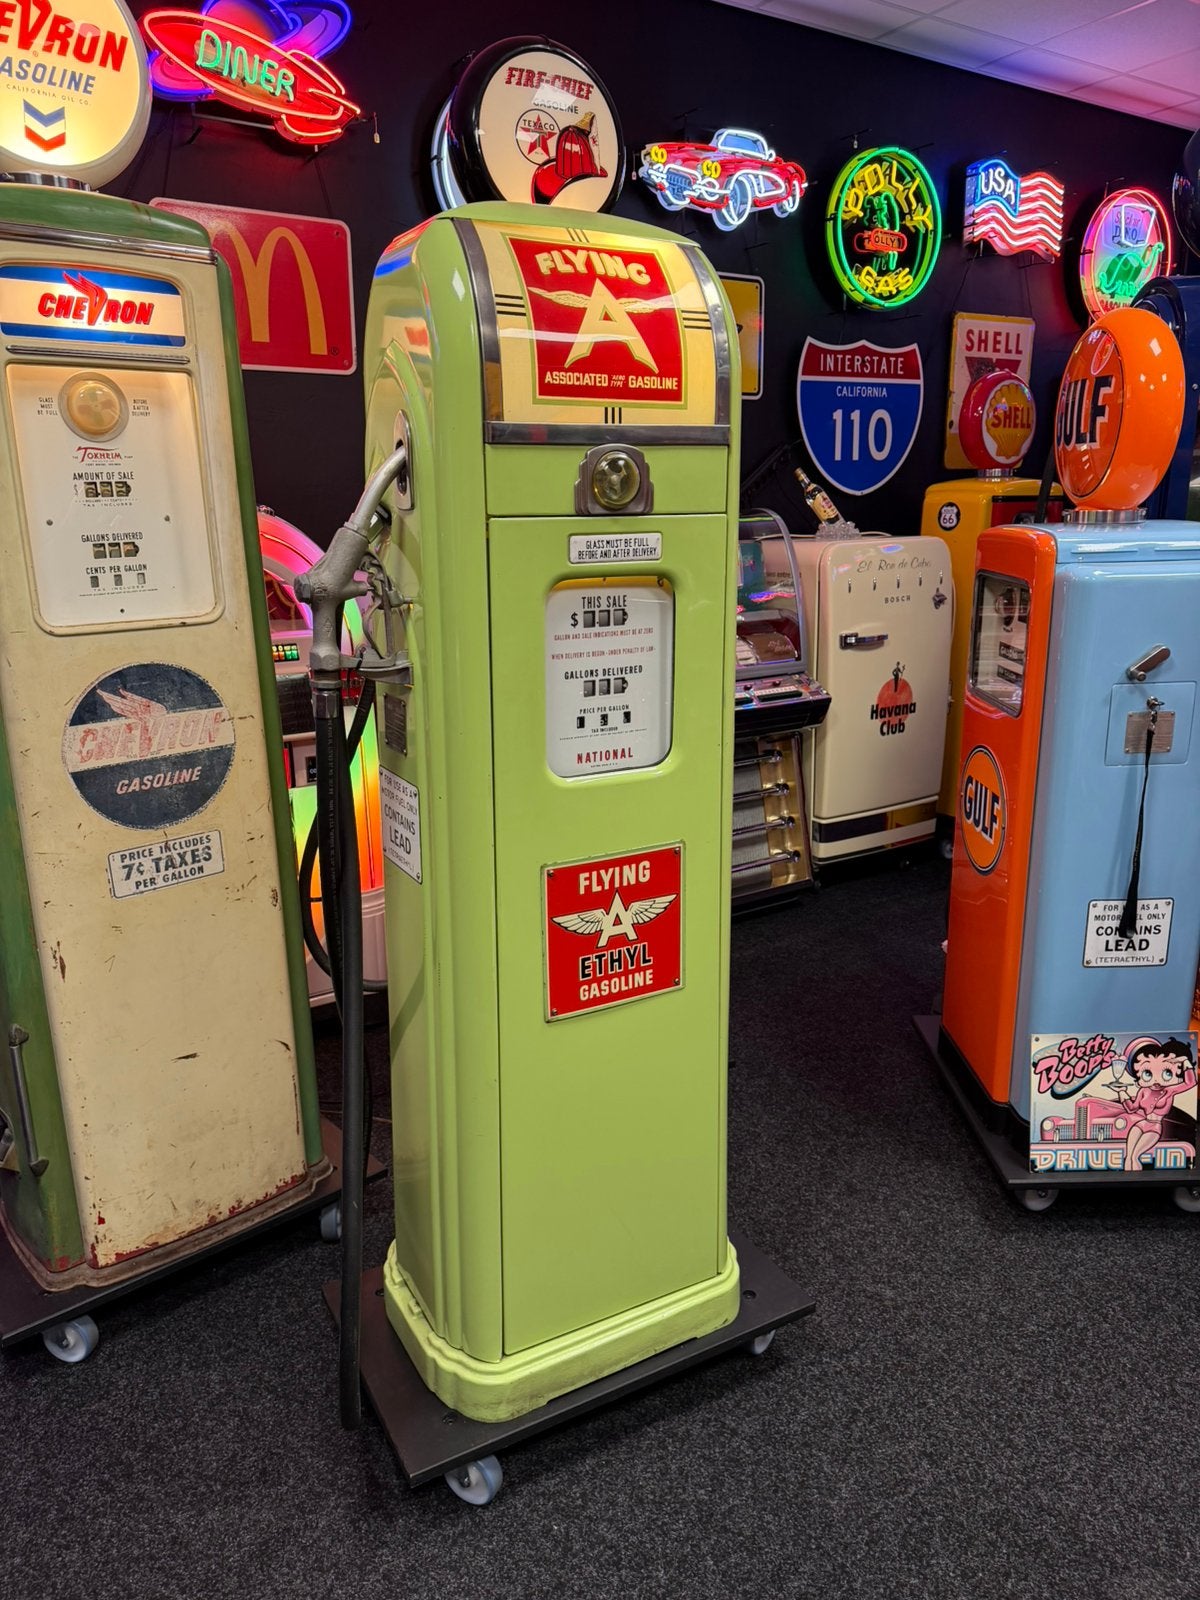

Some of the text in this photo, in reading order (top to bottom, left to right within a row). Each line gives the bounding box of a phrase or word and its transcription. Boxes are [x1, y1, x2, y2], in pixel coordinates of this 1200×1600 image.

[0, 55, 97, 95] ASOLINE
[195, 28, 295, 102] DINER
[6, 83, 57, 99] CALIFORNIA
[61, 94, 75, 103] OIL
[504, 66, 595, 101] FIRE-CHIEF
[522, 119, 556, 132] TEXACO
[980, 166, 1016, 206] USA
[1114, 225, 1138, 240] DNO
[534, 249, 652, 286] FLYING
[860, 265, 914, 295] GAS
[37, 278, 155, 327] CHEVRON
[964, 328, 1024, 355] SHELL
[819, 353, 905, 375] INTERSTATE
[544, 371, 609, 387] ASSOCIATED
[628, 375, 679, 390] GASOLINE
[836, 385, 888, 398] CALIFORNIA
[990, 405, 1032, 430] SHELL
[832, 408, 893, 461] 110
[72, 471, 135, 481] AMOUNT OF SALE
[942, 515, 955, 525] 66
[81, 531, 144, 543] GALLONS DELIVERED
[585, 537, 650, 550] GLASS MUST BE FULL
[578, 547, 657, 560] BEFORE AND AFTER DELIVERY
[86, 563, 148, 575] CENTS PER GALLON
[582, 595, 628, 610] THIS SALE
[884, 594, 911, 604] BOSCH
[570, 611, 579, 628] $
[564, 665, 643, 680] GALLONS DELIVERED
[579, 707, 596, 715] PRICE
[608, 704, 630, 712] GALLON
[870, 701, 917, 720] Havana
[880, 717, 906, 737] Club
[576, 746, 634, 764] NATIONAL
[116, 766, 202, 795] GASOLINE
[384, 802, 416, 836] CONTAINS
[963, 774, 1001, 845] GULF
[120, 834, 212, 863] PRICE INCLUDES
[389, 824, 412, 855] LEAD
[121, 845, 212, 882] 7¢ TAXES
[135, 864, 205, 890] PER GALLON
[579, 860, 651, 895] FLYING
[1094, 914, 1122, 922] MOTOR
[1103, 904, 1119, 912] FOR
[1095, 924, 1162, 937] CONINS
[1104, 938, 1150, 952] LEAD
[579, 942, 654, 982] ETHYL
[579, 969, 654, 1001] GASOLINE
[1058, 1034, 1115, 1064] Betty
